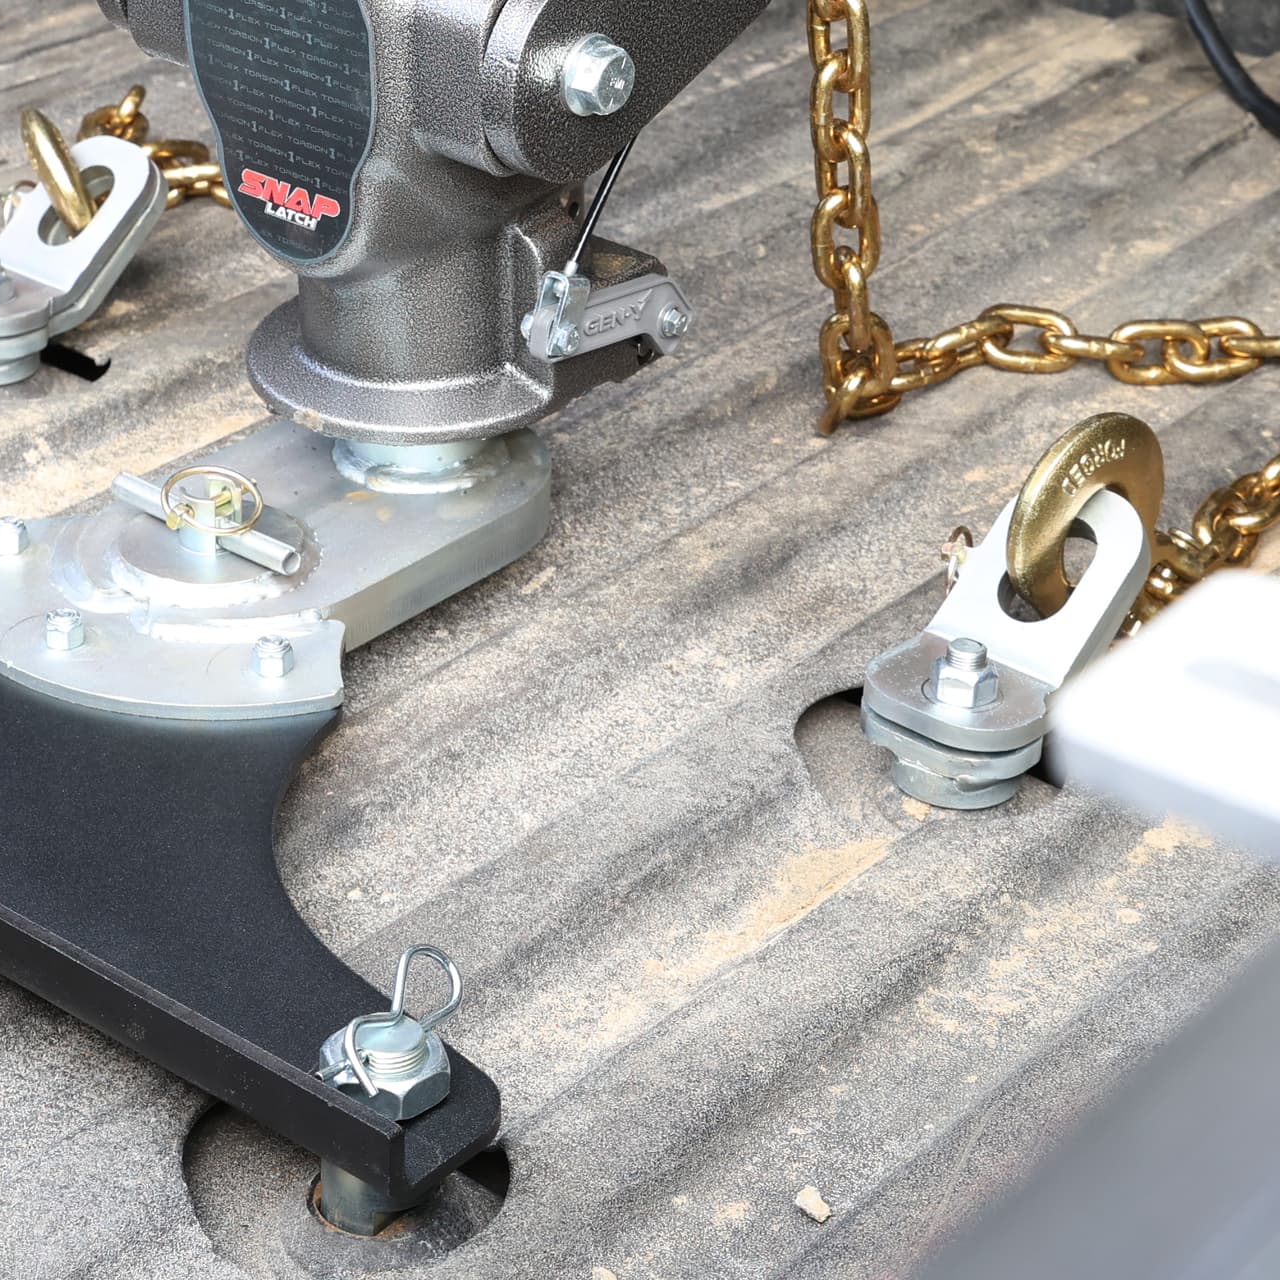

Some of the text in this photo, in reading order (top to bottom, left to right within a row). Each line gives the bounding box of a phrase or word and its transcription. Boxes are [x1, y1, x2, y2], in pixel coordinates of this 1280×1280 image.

[237, 167, 341, 218] SNAP
[264, 200, 320, 231] LATCH
[584, 289, 653, 337] GEN-Y
